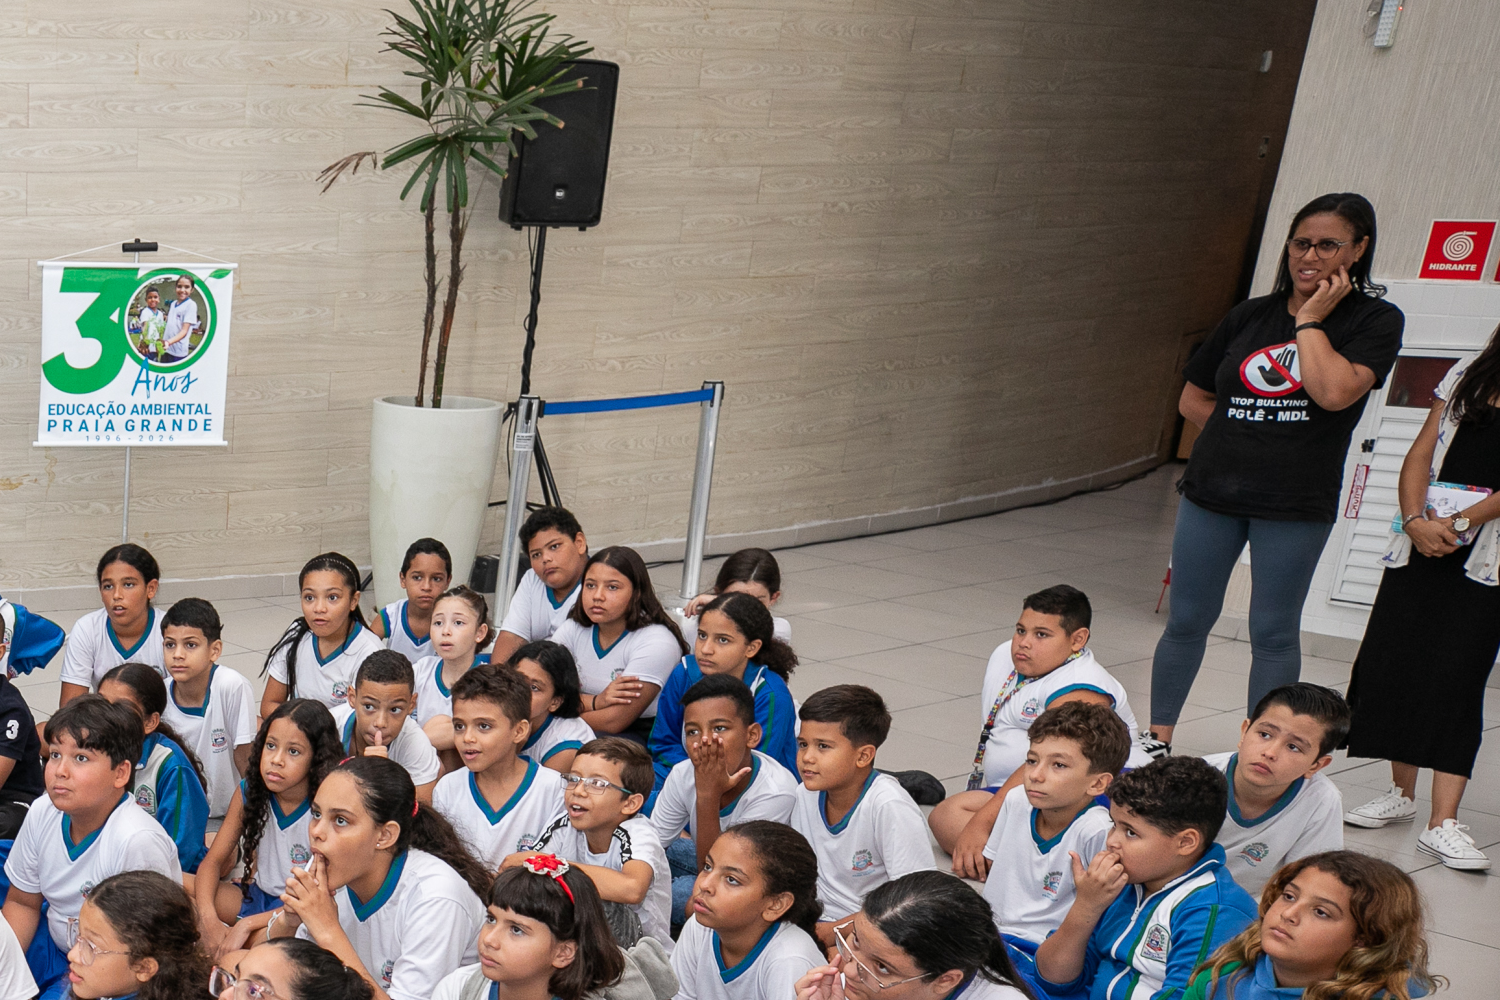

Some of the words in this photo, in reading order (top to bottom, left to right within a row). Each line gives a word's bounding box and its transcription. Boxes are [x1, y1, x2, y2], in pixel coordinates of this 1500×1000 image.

[1428, 263, 1478, 272] HIDRANTE
[131, 356, 198, 400] Anos
[1230, 397, 1255, 406] STOP
[1255, 398, 1309, 407] BULLYING
[48, 400, 126, 419] EDUCAÇÃO
[130, 403, 212, 416] AMBIENTAL
[1277, 411, 1310, 421] MDL
[47, 419, 115, 432] PRAIA
[124, 419, 212, 432] GRANDE
[6, 719, 19, 739] 3
